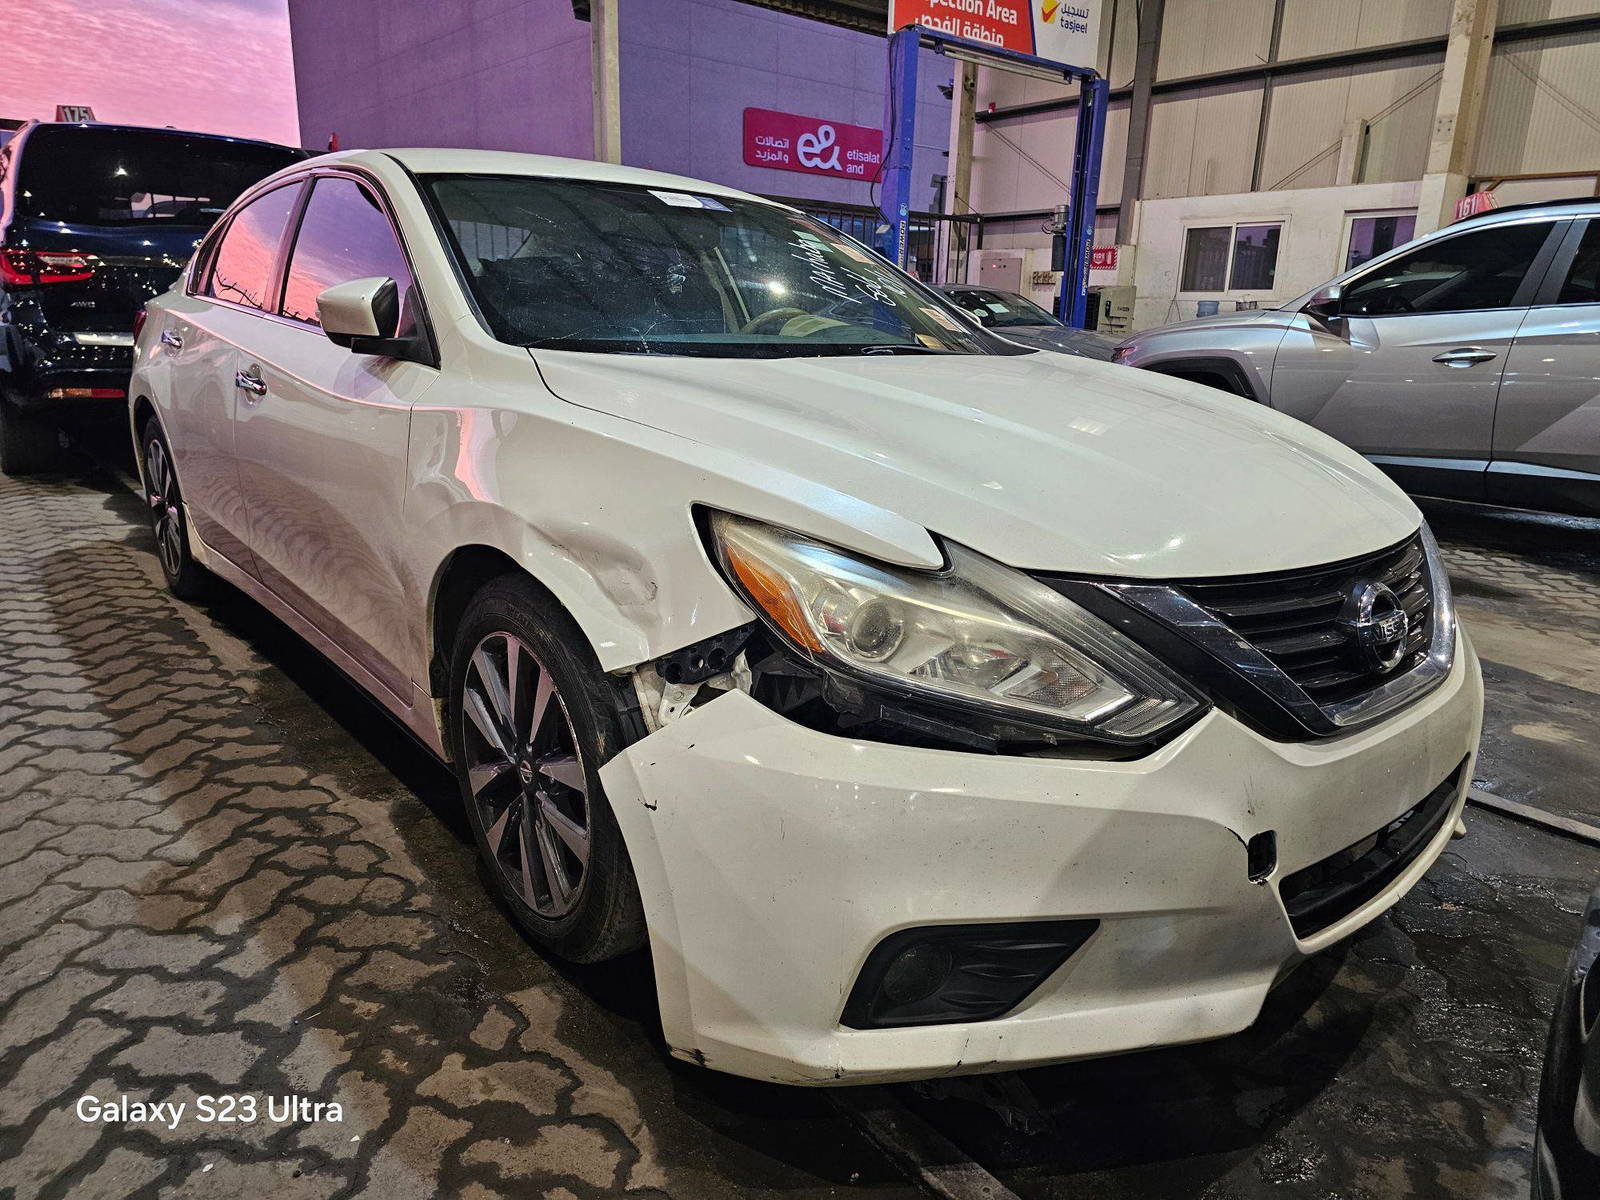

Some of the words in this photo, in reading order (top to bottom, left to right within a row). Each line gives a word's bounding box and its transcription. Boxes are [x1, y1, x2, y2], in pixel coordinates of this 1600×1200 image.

[986, 0, 1018, 25] Area
[1061, 3, 1089, 19] تسجيل
[1061, 16, 1088, 33] tasjeel
[963, 20, 1004, 46] منطقة
[755, 135, 789, 149] اتصالات
[846, 149, 880, 164] etisalat
[846, 162, 864, 175] and
[1458, 196, 1477, 218] 161
